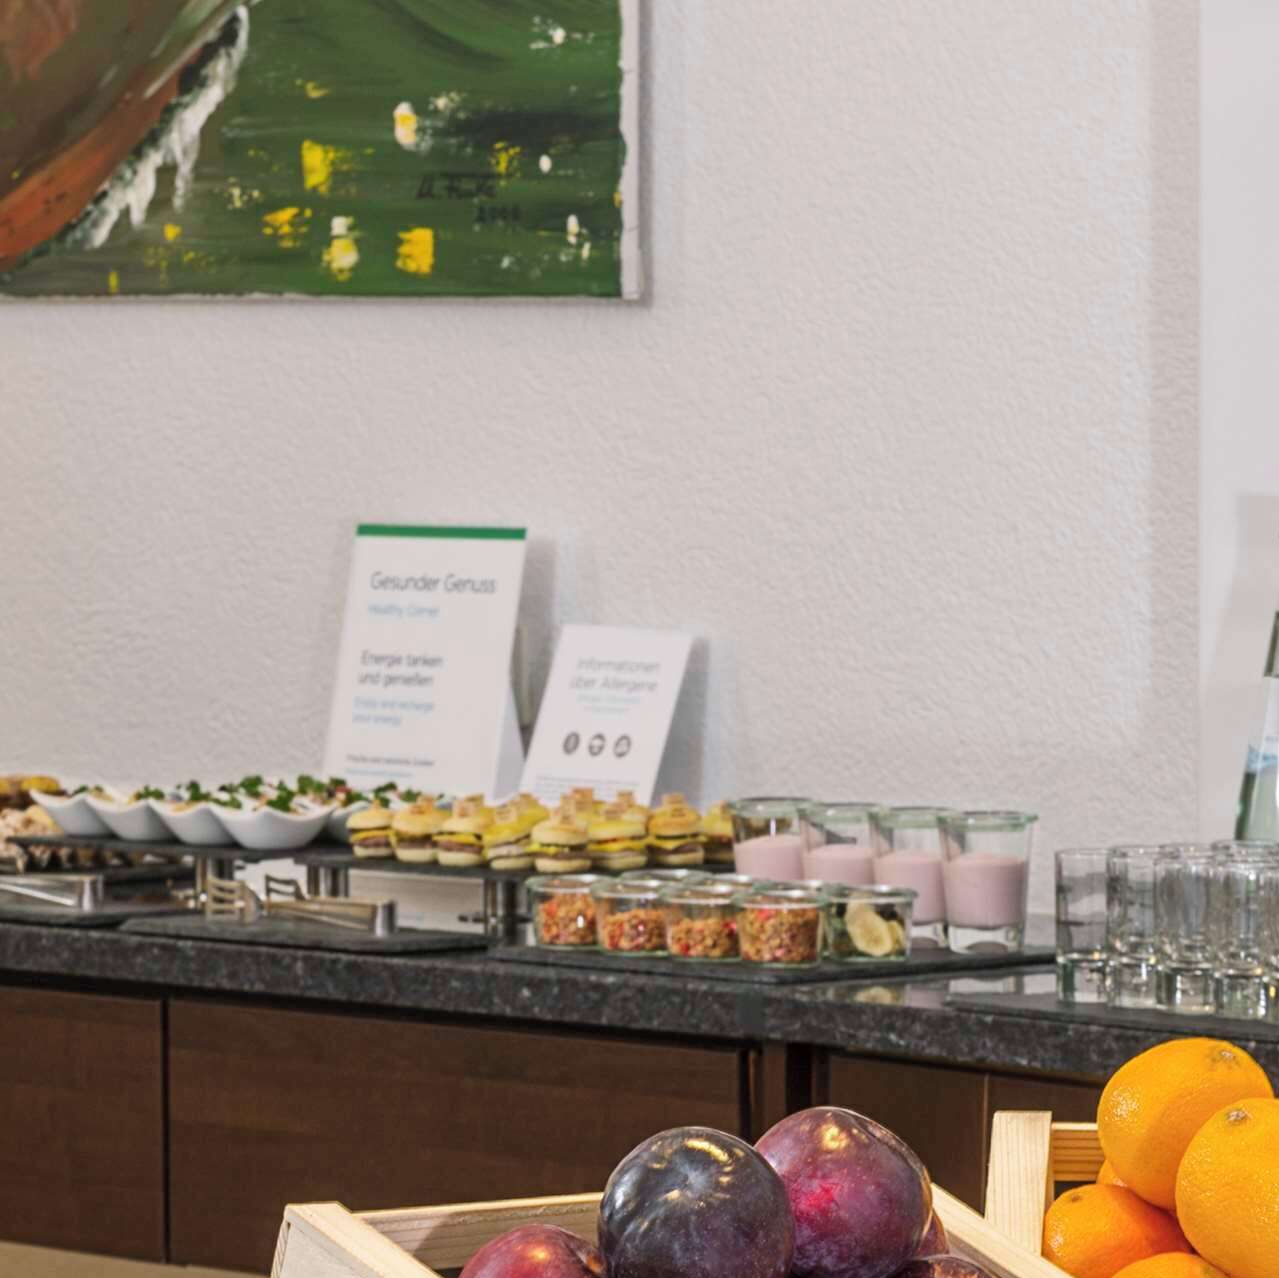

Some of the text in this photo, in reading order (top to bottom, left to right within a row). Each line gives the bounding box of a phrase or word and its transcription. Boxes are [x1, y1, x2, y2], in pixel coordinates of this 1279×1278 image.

[370, 571, 496, 594] Gesunder Genuss
[360, 650, 402, 668] Energie
[358, 673, 380, 685] und
